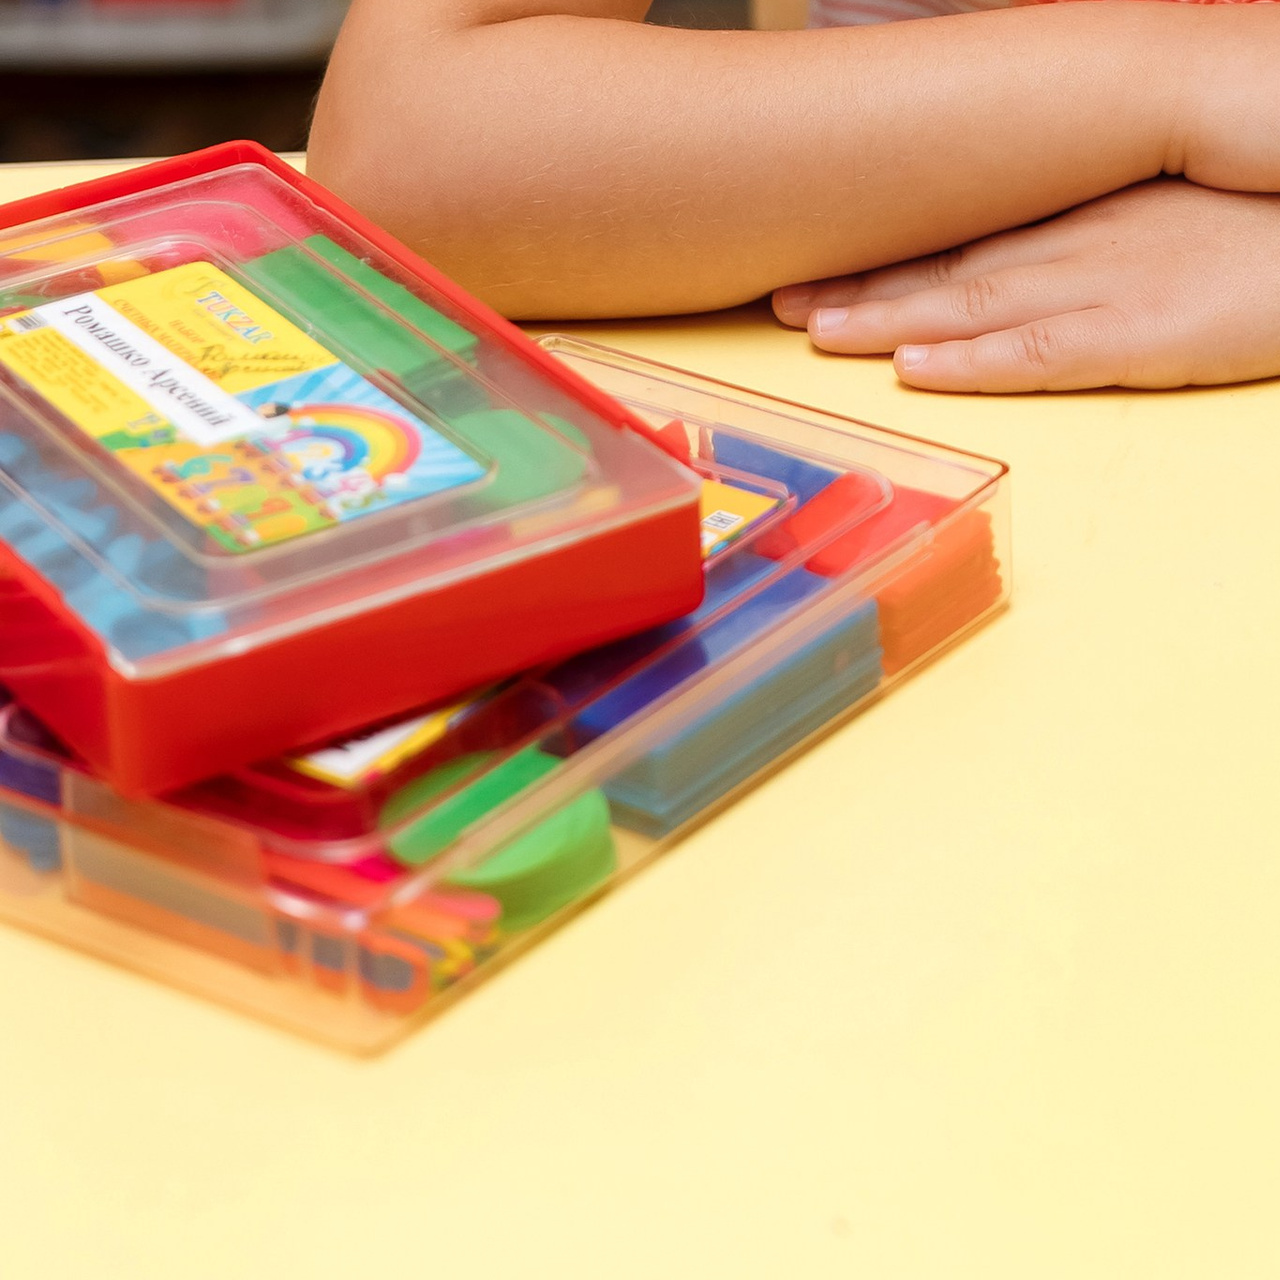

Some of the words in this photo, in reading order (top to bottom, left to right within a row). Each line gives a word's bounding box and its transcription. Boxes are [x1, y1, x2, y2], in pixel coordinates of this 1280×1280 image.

[197, 291, 271, 344] TUKZAR
[63, 305, 150, 367] Ромашко
[142, 368, 236, 426] Арсений
